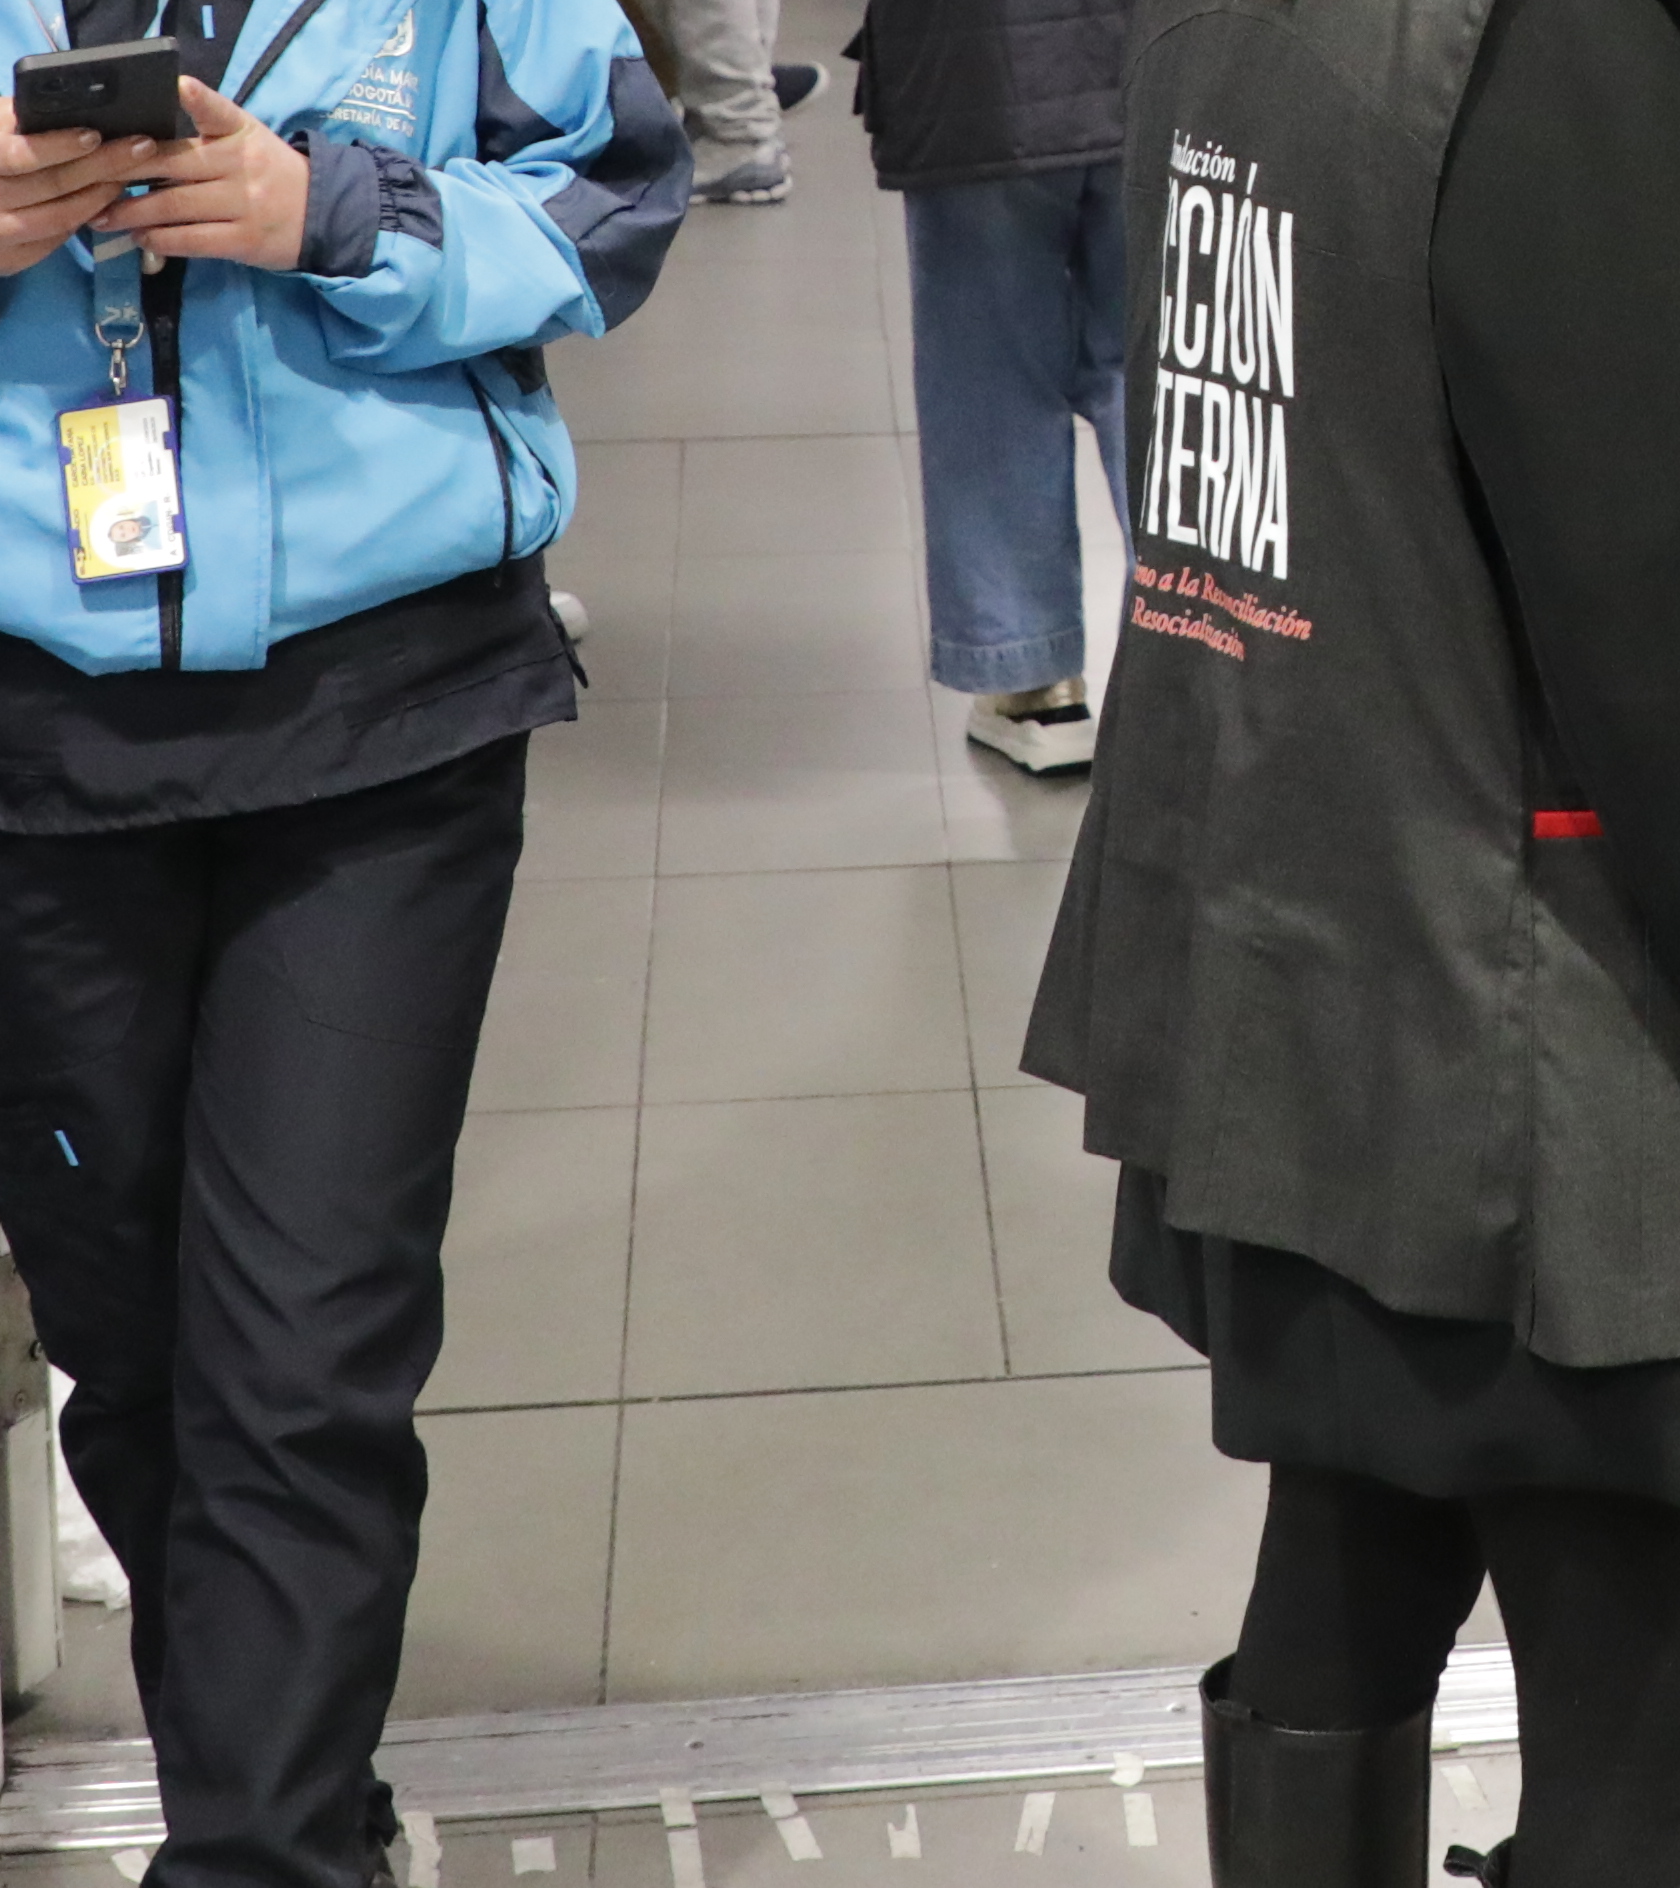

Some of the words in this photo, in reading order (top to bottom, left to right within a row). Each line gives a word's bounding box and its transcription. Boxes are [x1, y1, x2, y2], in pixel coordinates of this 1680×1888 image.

[1158, 162, 1295, 398] CCIÓN
[1140, 365, 1288, 580] TERNA
[1158, 572, 1175, 591] a
[1177, 567, 1200, 597] la
